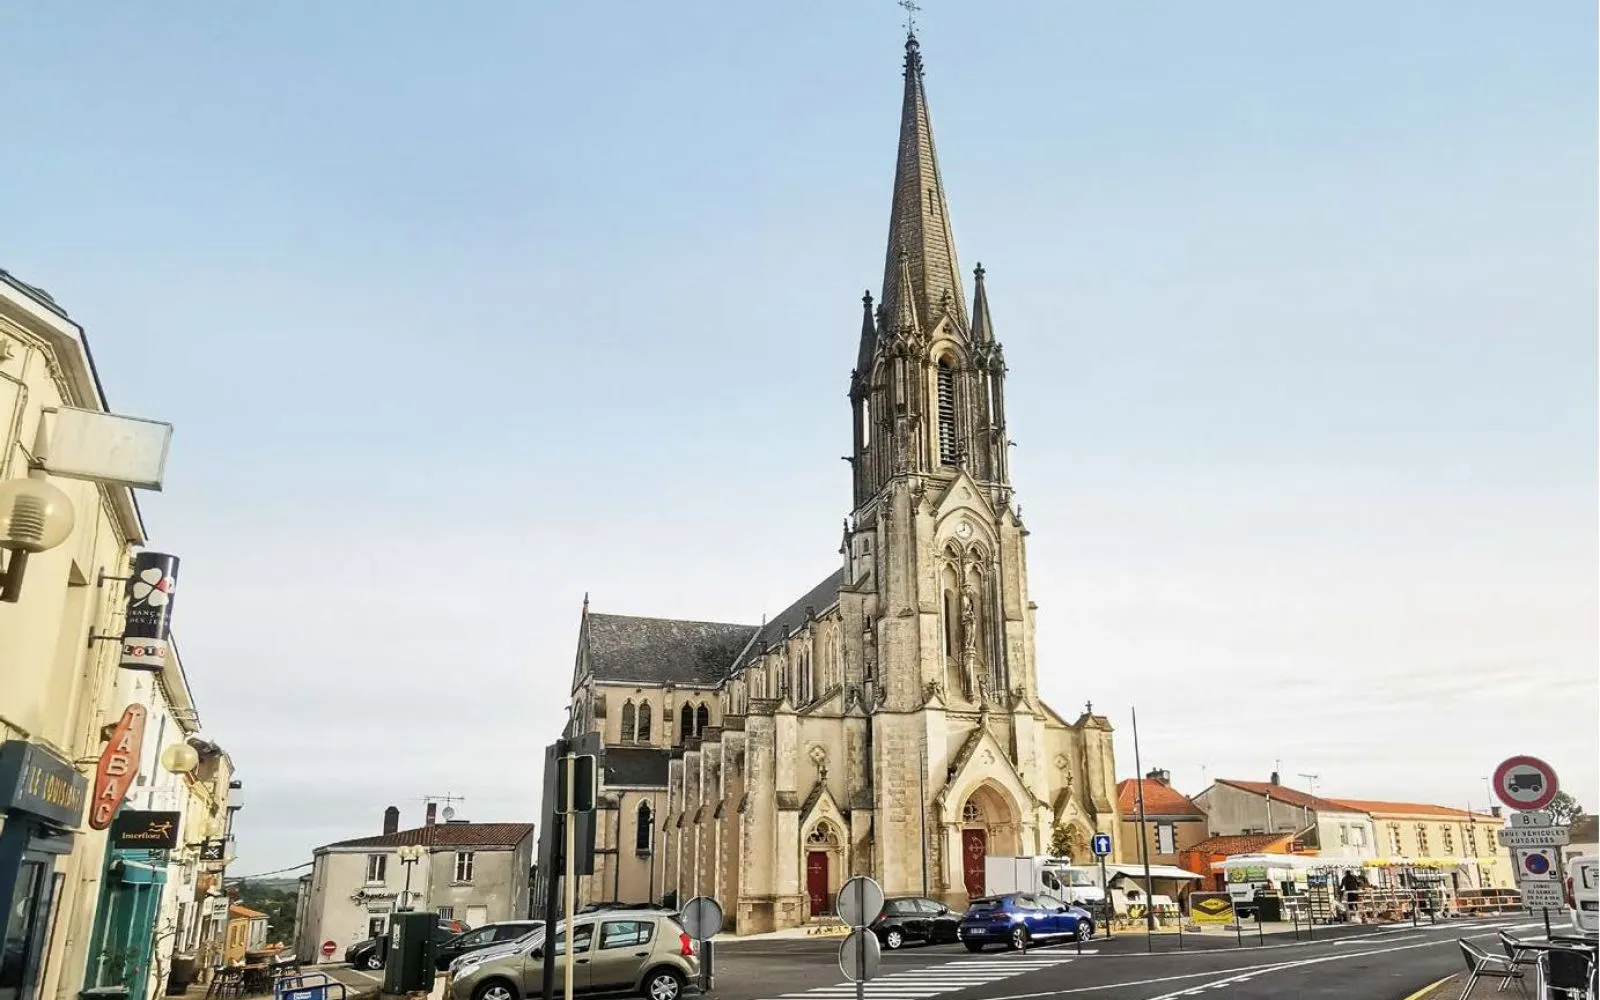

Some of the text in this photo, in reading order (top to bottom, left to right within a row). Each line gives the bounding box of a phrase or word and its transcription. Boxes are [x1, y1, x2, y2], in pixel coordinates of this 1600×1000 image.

[124, 644, 166, 658] LOTO
[95, 710, 141, 823] TABAC
[28, 766, 42, 796] LE
[121, 831, 160, 839] Interflora
